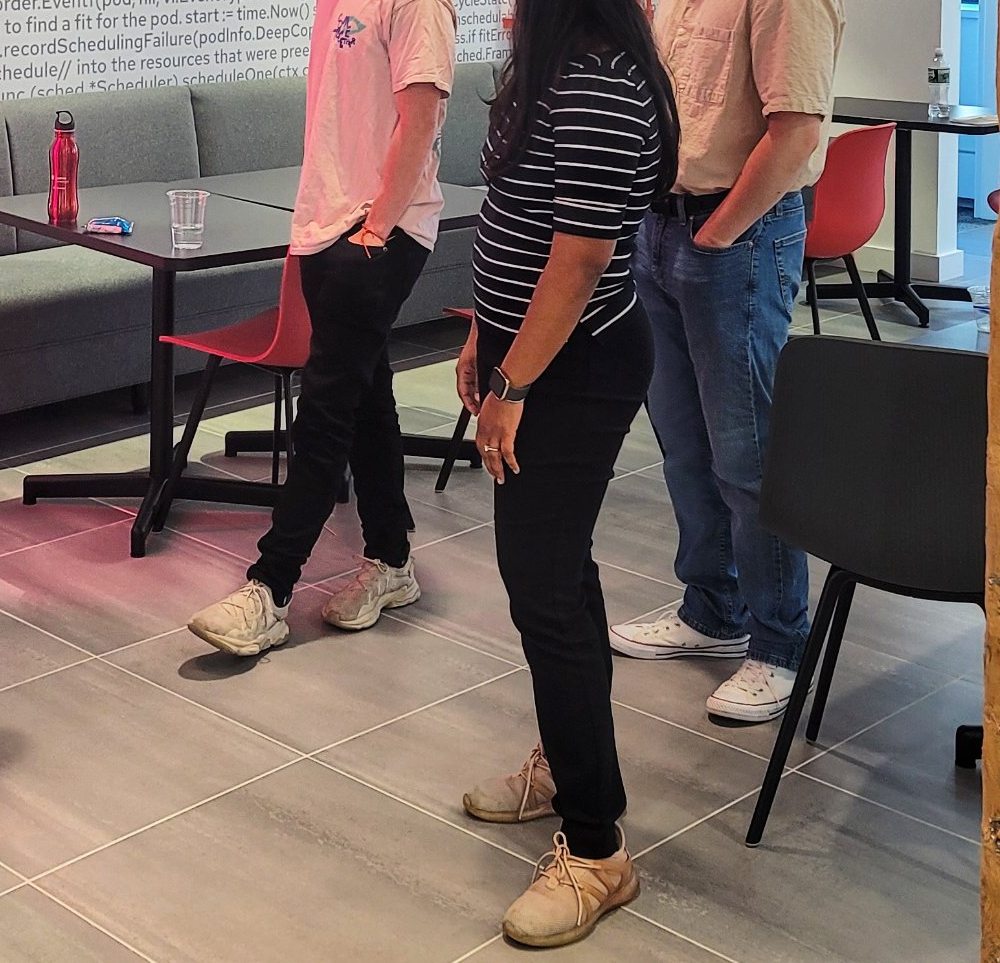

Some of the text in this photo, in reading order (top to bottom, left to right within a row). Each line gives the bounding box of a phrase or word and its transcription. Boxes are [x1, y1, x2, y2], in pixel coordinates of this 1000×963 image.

[4, 19, 22, 36] to
[26, 15, 58, 33] find
[62, 19, 71, 31] a
[74, 13, 93, 30] fit
[96, 12, 118, 29] for
[123, 12, 147, 28] the
[150, 9, 182, 30] pod.
[185, 7, 219, 25] start
[237, 3, 309, 21] time.Now()
[77, 58, 106, 76] into
[111, 54, 136, 72] the
[141, 54, 210, 69] resources
[214, 48, 242, 64] that
[246, 48, 277, 61] were
